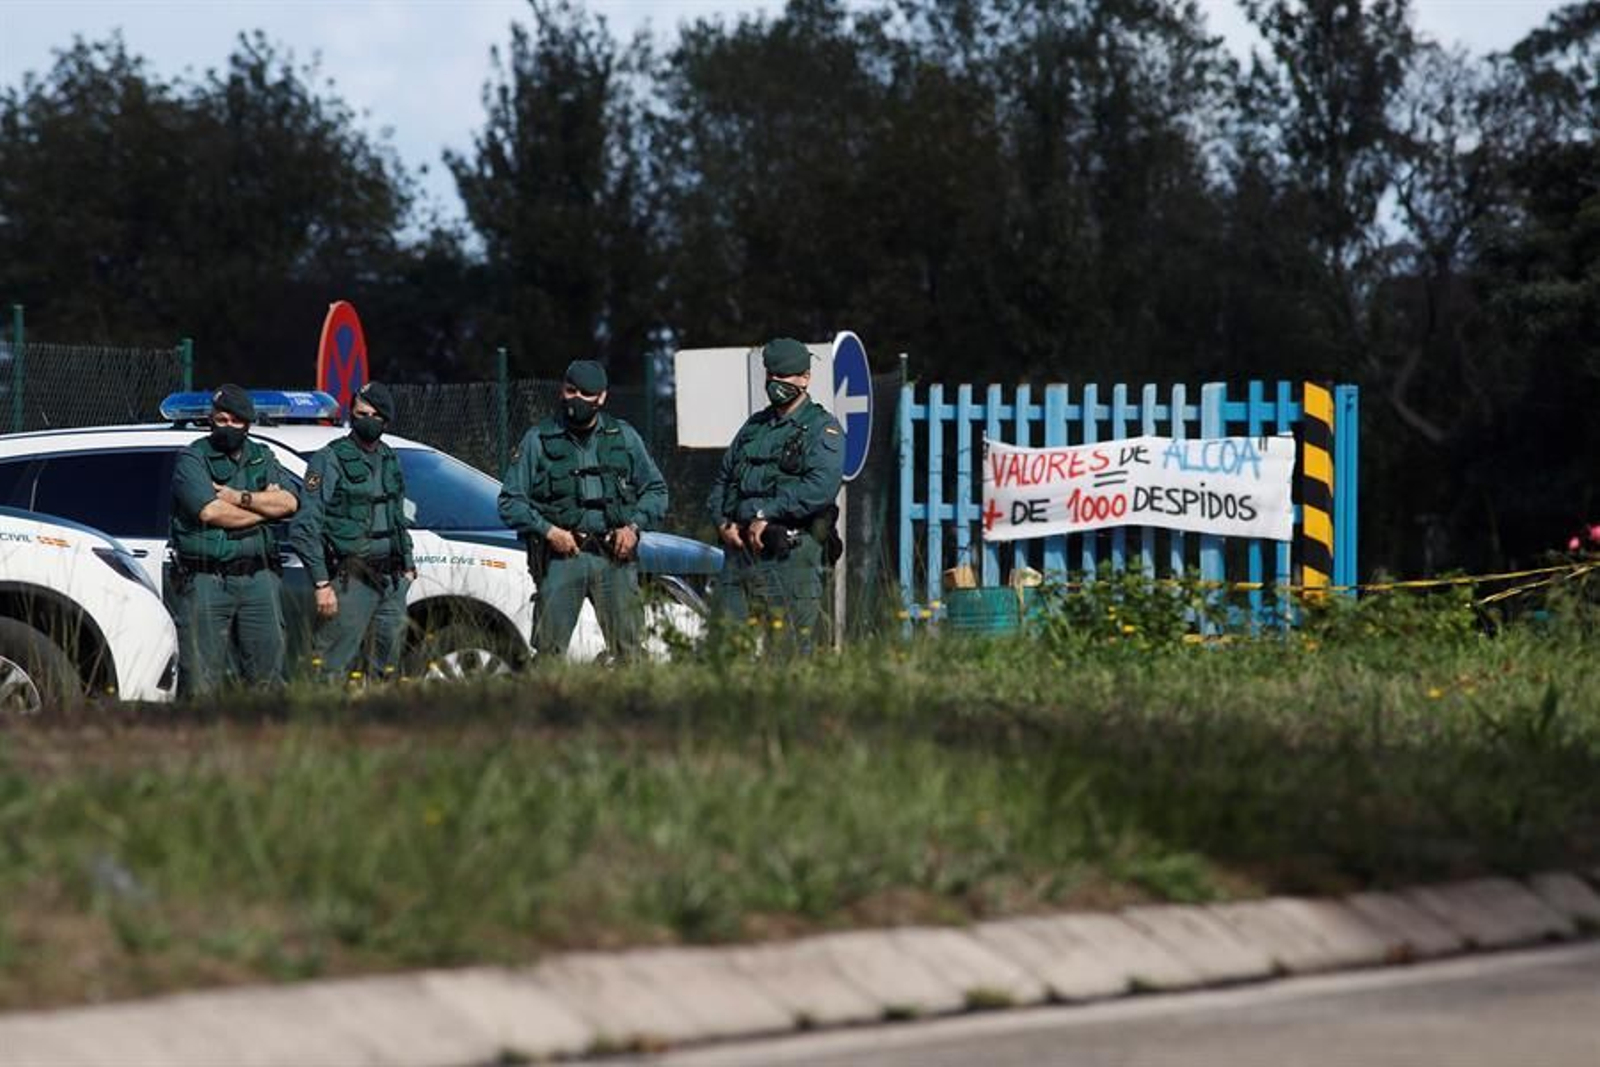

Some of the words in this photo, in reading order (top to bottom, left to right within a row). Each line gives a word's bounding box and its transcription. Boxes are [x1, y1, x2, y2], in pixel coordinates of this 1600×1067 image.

[991, 449, 1110, 487] VALORES
[1119, 445, 1150, 466] DE
[1011, 498, 1050, 525] DE
[1067, 488, 1127, 523] 1000
[1132, 482, 1258, 522] DESPIDOS
[0, 532, 32, 543] CIVIL
